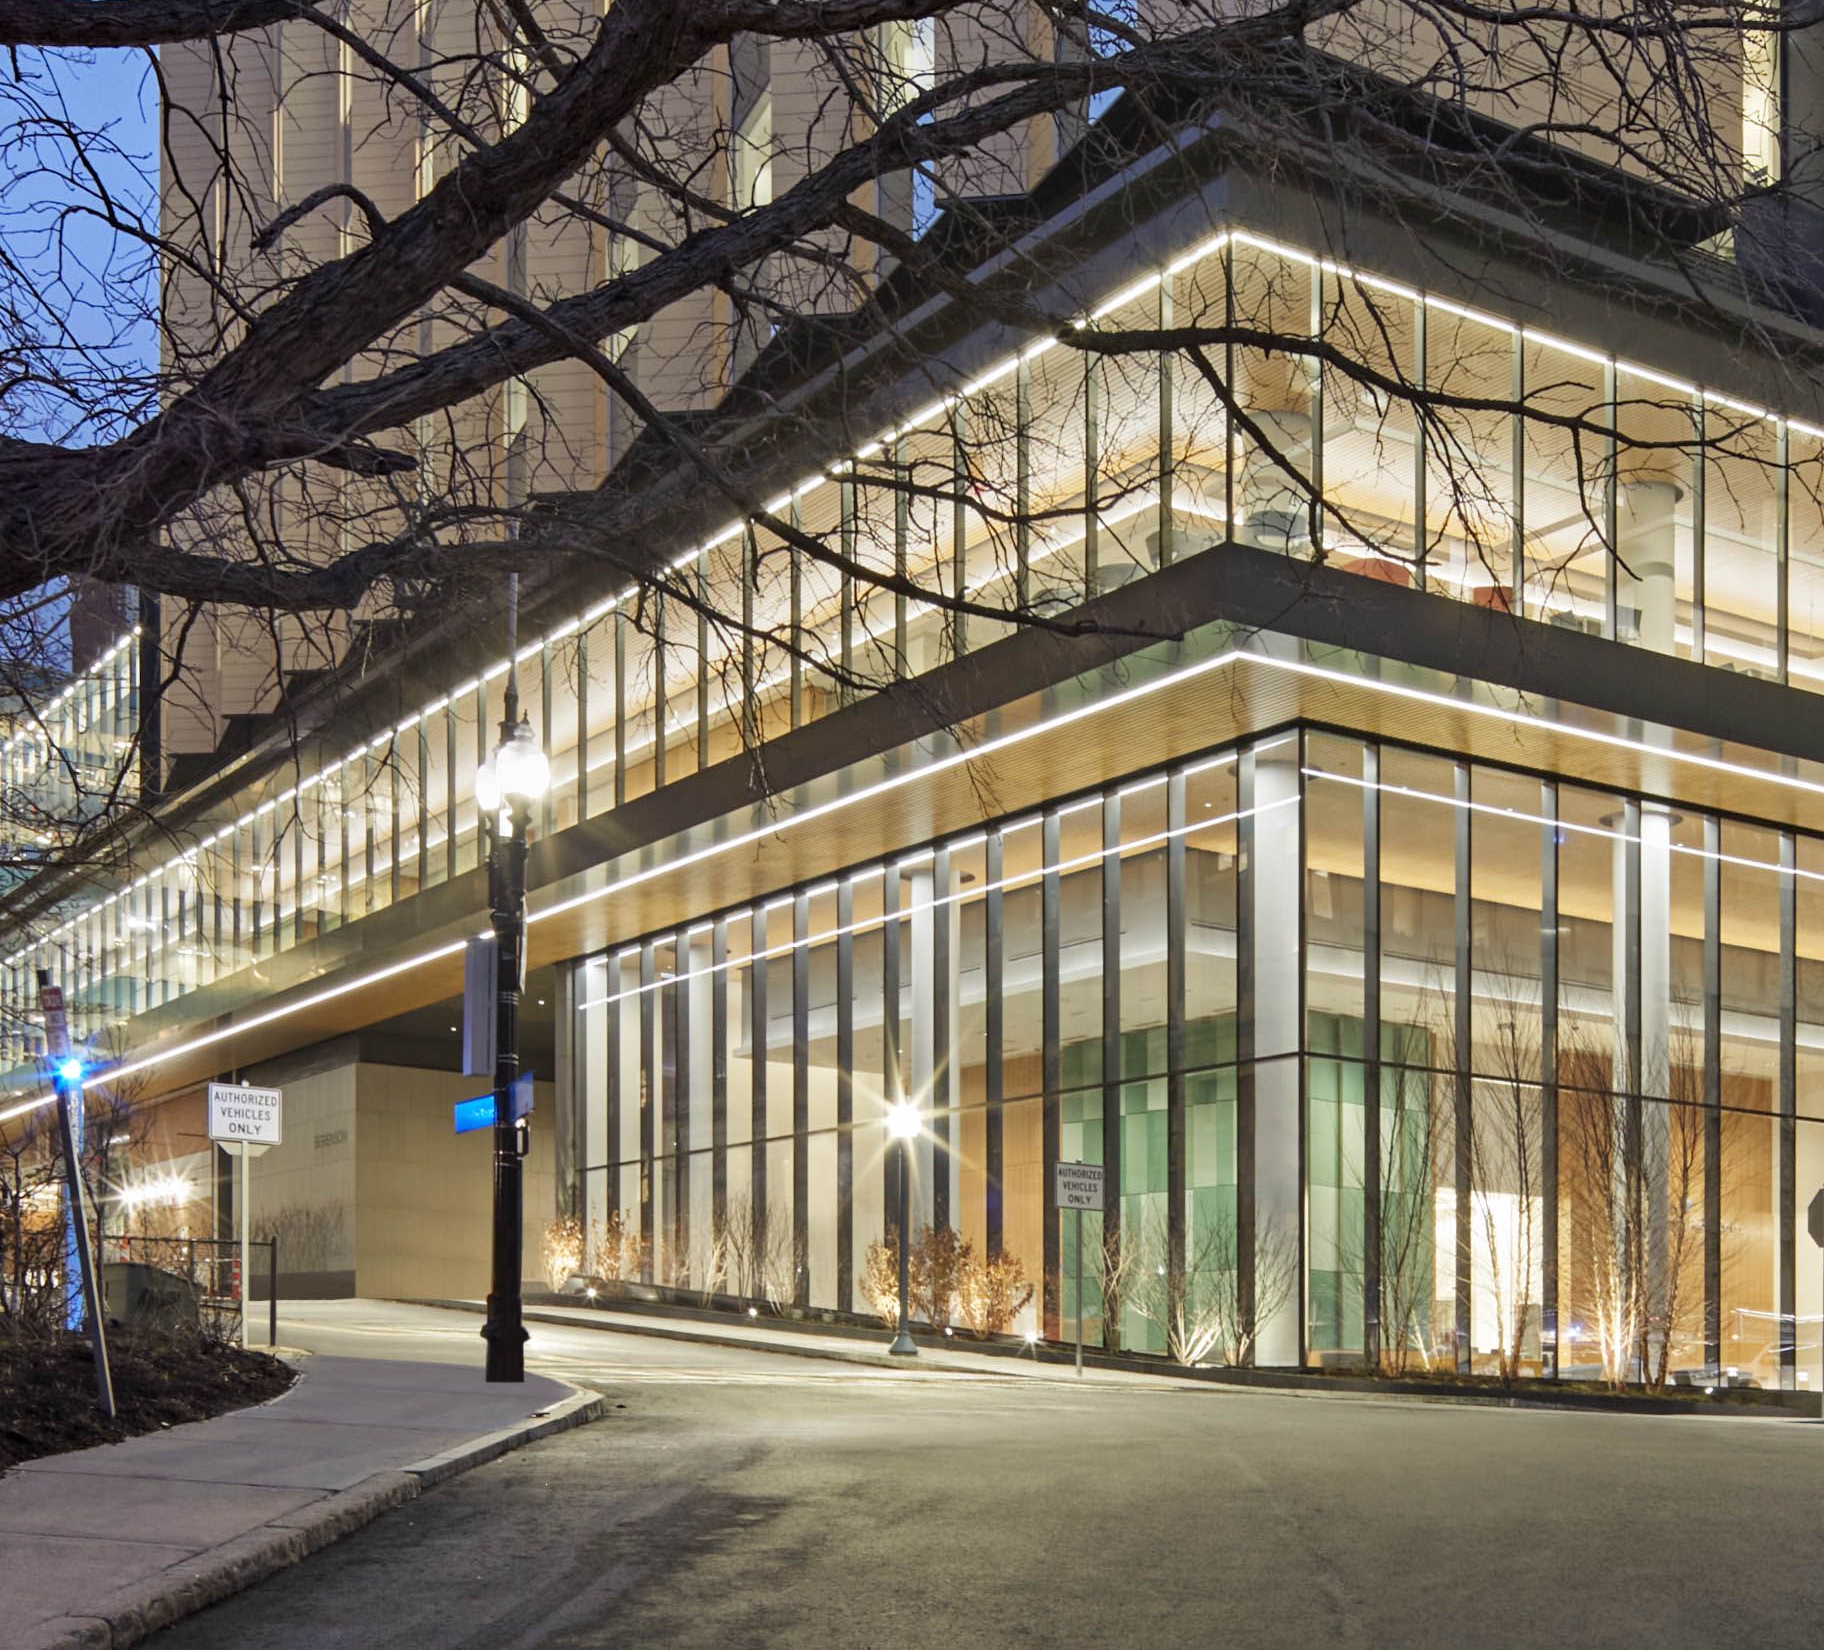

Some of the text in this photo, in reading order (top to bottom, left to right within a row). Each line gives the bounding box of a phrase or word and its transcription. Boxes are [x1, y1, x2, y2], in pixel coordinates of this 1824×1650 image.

[214, 1091, 278, 1107] AUTHORIZED
[221, 1107, 271, 1121] VEHICLES
[228, 1122, 261, 1135] ONLY
[1058, 1167, 1103, 1180] AUTHORIZED
[1063, 1181, 1098, 1192] VEHICLES
[1068, 1194, 1091, 1204] ONLY
